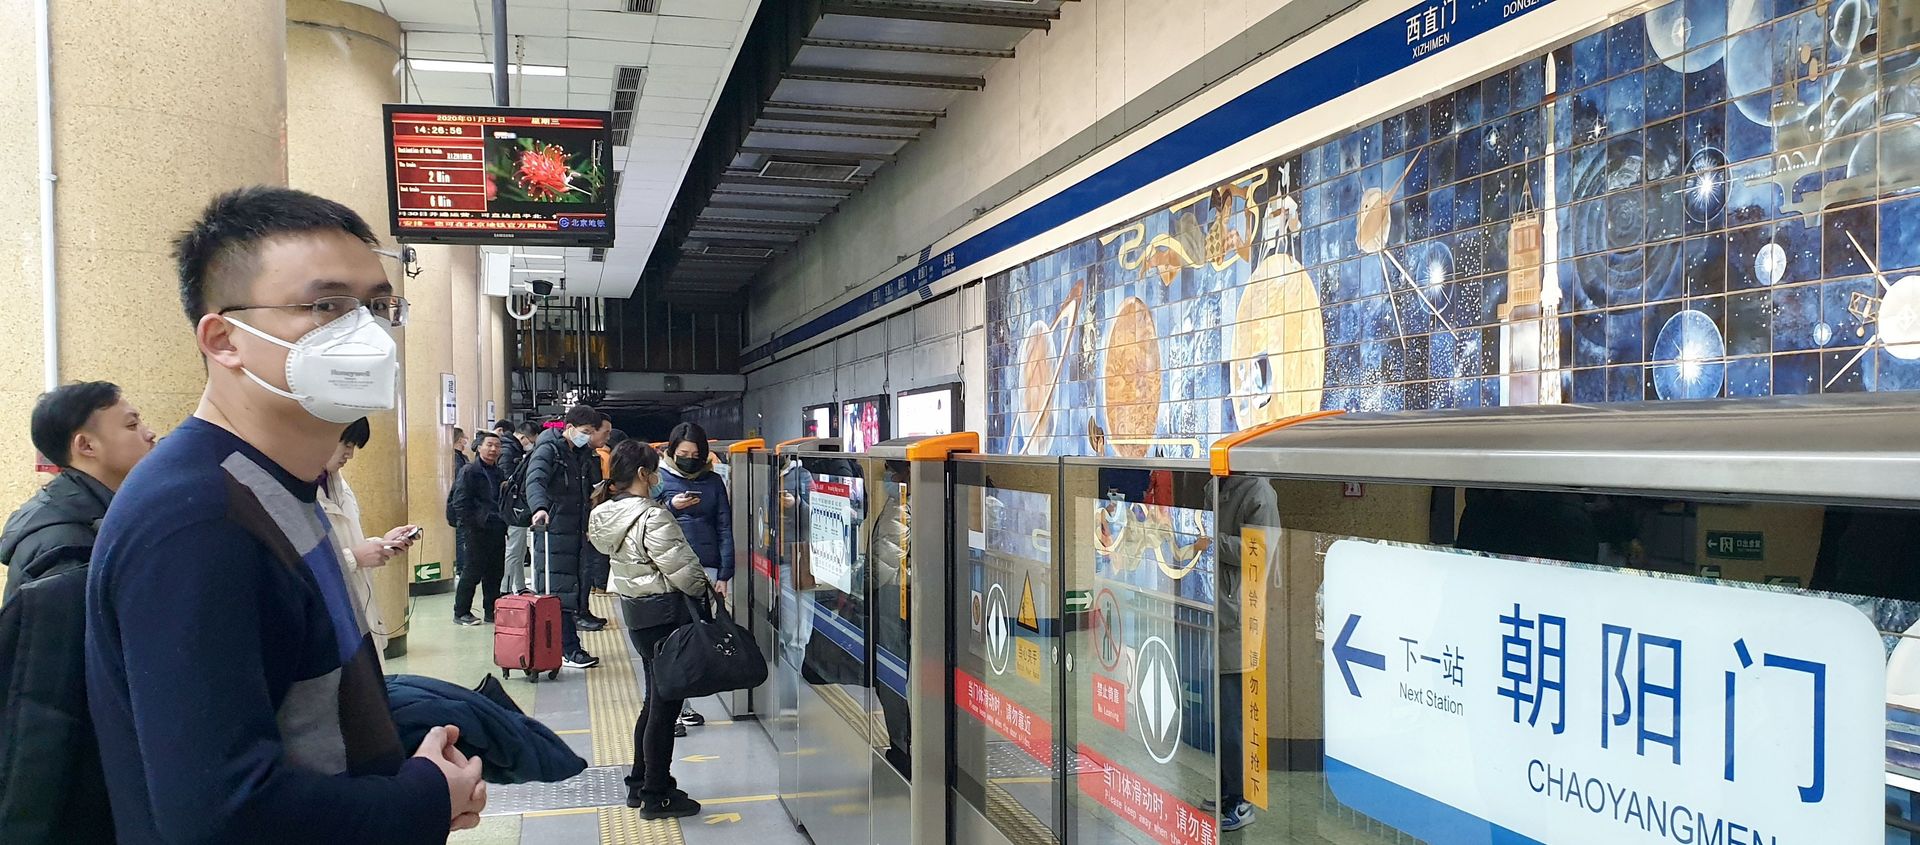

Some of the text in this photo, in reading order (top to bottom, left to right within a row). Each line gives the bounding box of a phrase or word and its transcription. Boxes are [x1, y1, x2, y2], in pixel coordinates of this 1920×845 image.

[1406, 0, 1457, 45] 西直门
[1412, 32, 1450, 59] XIZHIMEN
[437, 115, 506, 124] 2020年01月22日
[531, 117, 560, 125] 星期三
[428, 170, 434, 182] 2
[331, 369, 370, 377] Honeywell
[1399, 636, 1464, 687] 下一站
[1399, 681, 1464, 717] Next Station
[1497, 603, 1826, 803] 朝阳门
[1103, 705, 1120, 723] Leaning
[1104, 788, 1123, 810] Please
[1124, 801, 1137, 821] keep
[1138, 814, 1152, 830] away
[1154, 823, 1168, 839] when
